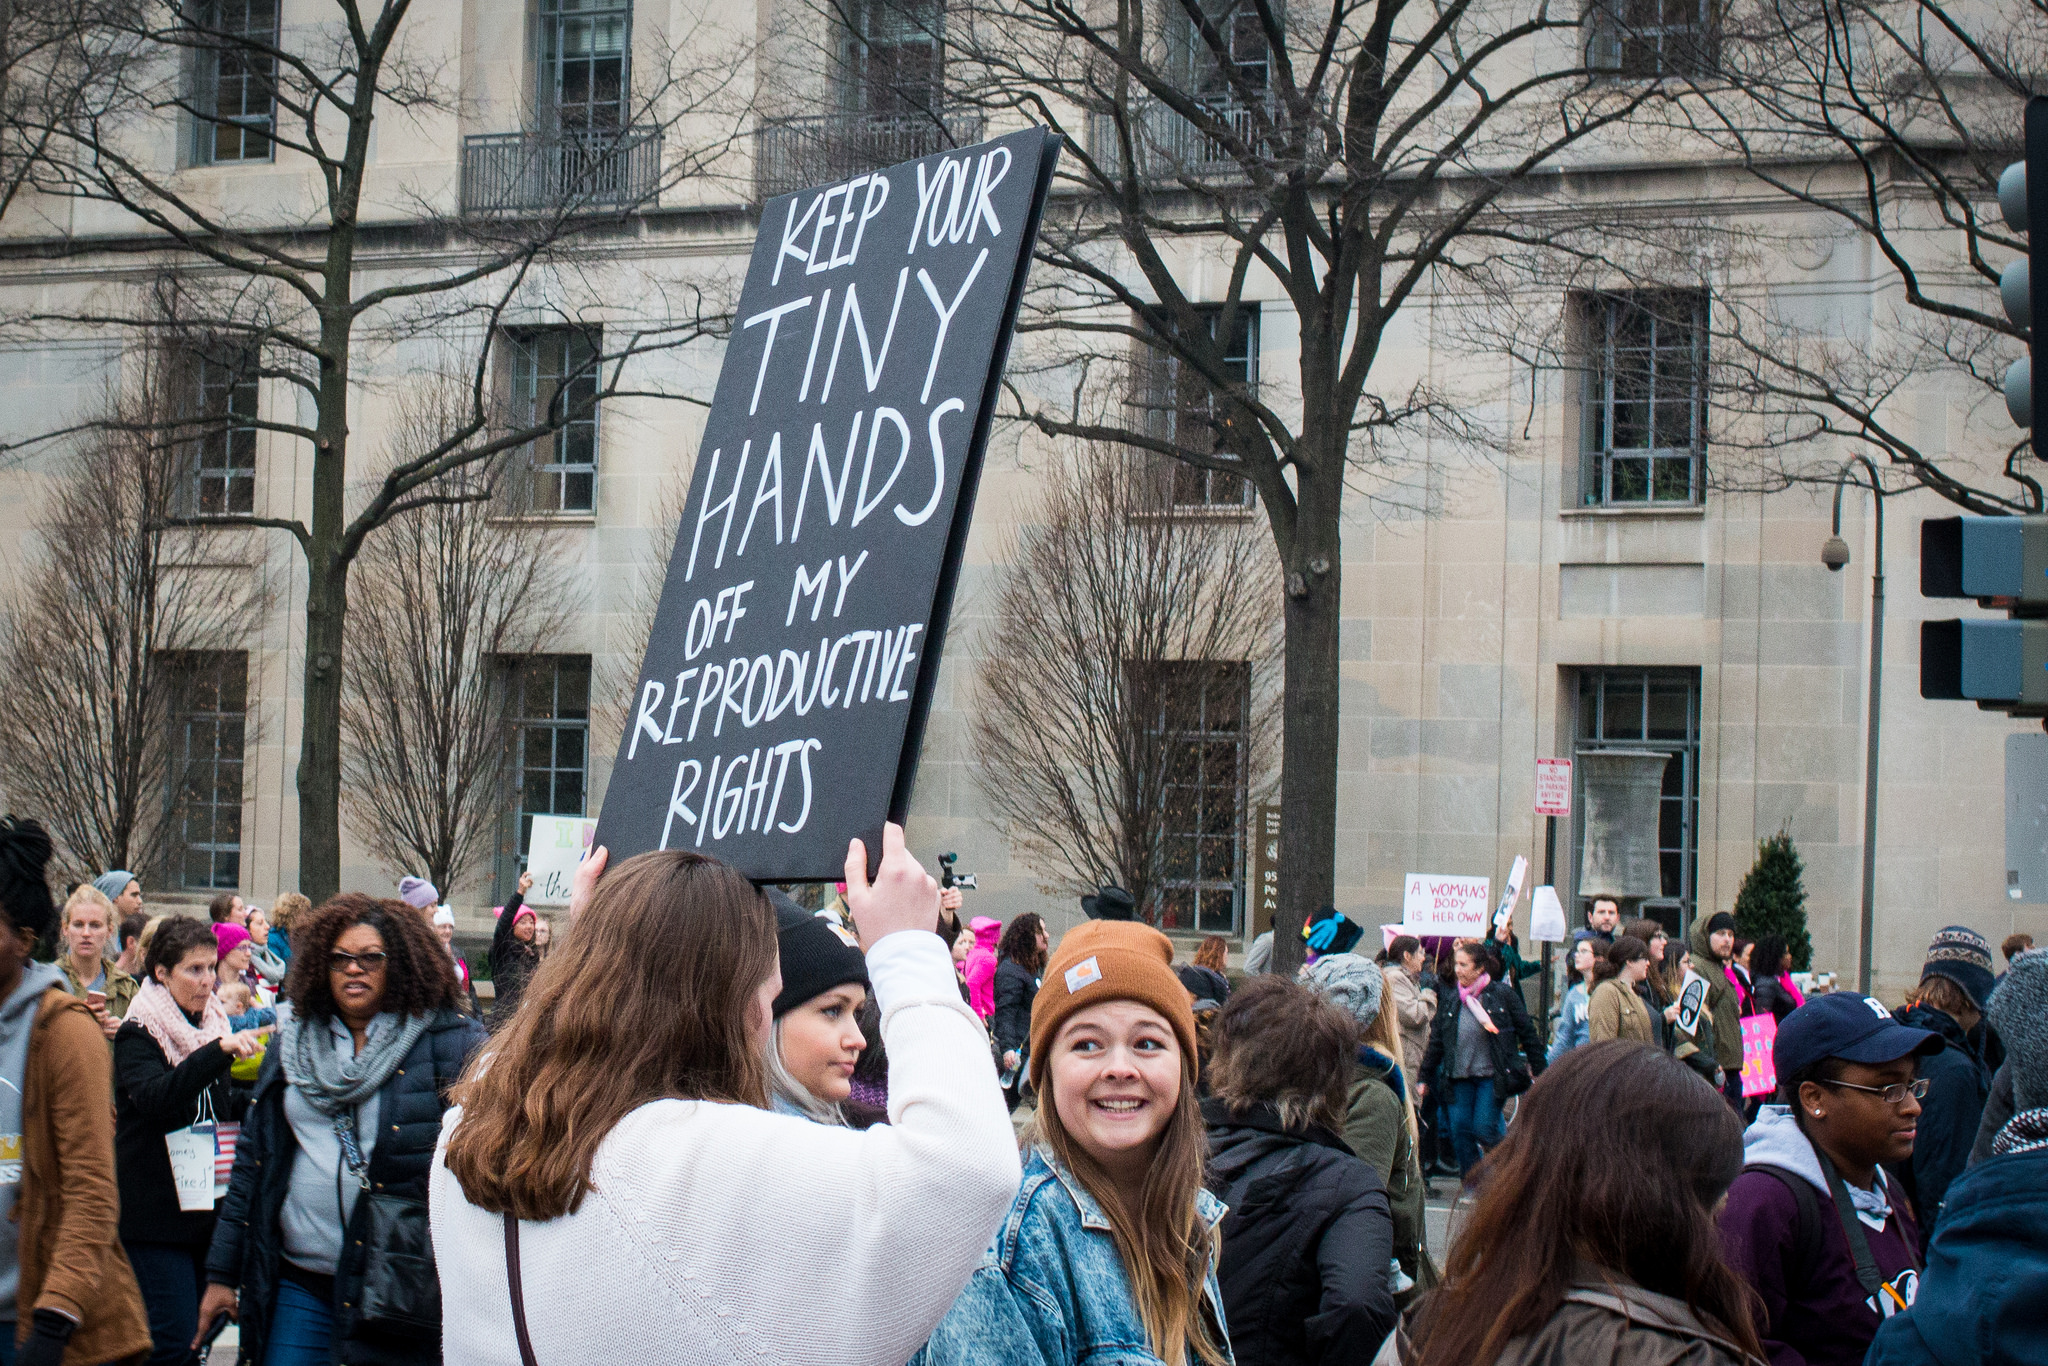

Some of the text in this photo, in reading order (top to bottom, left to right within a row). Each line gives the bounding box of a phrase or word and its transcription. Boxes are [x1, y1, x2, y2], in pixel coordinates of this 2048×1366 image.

[772, 147, 1012, 286] KEEP YOUR
[744, 248, 989, 416] TINY
[685, 398, 964, 582] HANDS
[685, 550, 868, 661] OFF MY
[628, 623, 923, 760] REPRODUCTIVE
[659, 738, 822, 852] RIGHTS
[1411, 881, 1486, 900] A WOMANS
[1411, 910, 1483, 923] IS HER OWN
[1434, 897, 1466, 910] BODY
